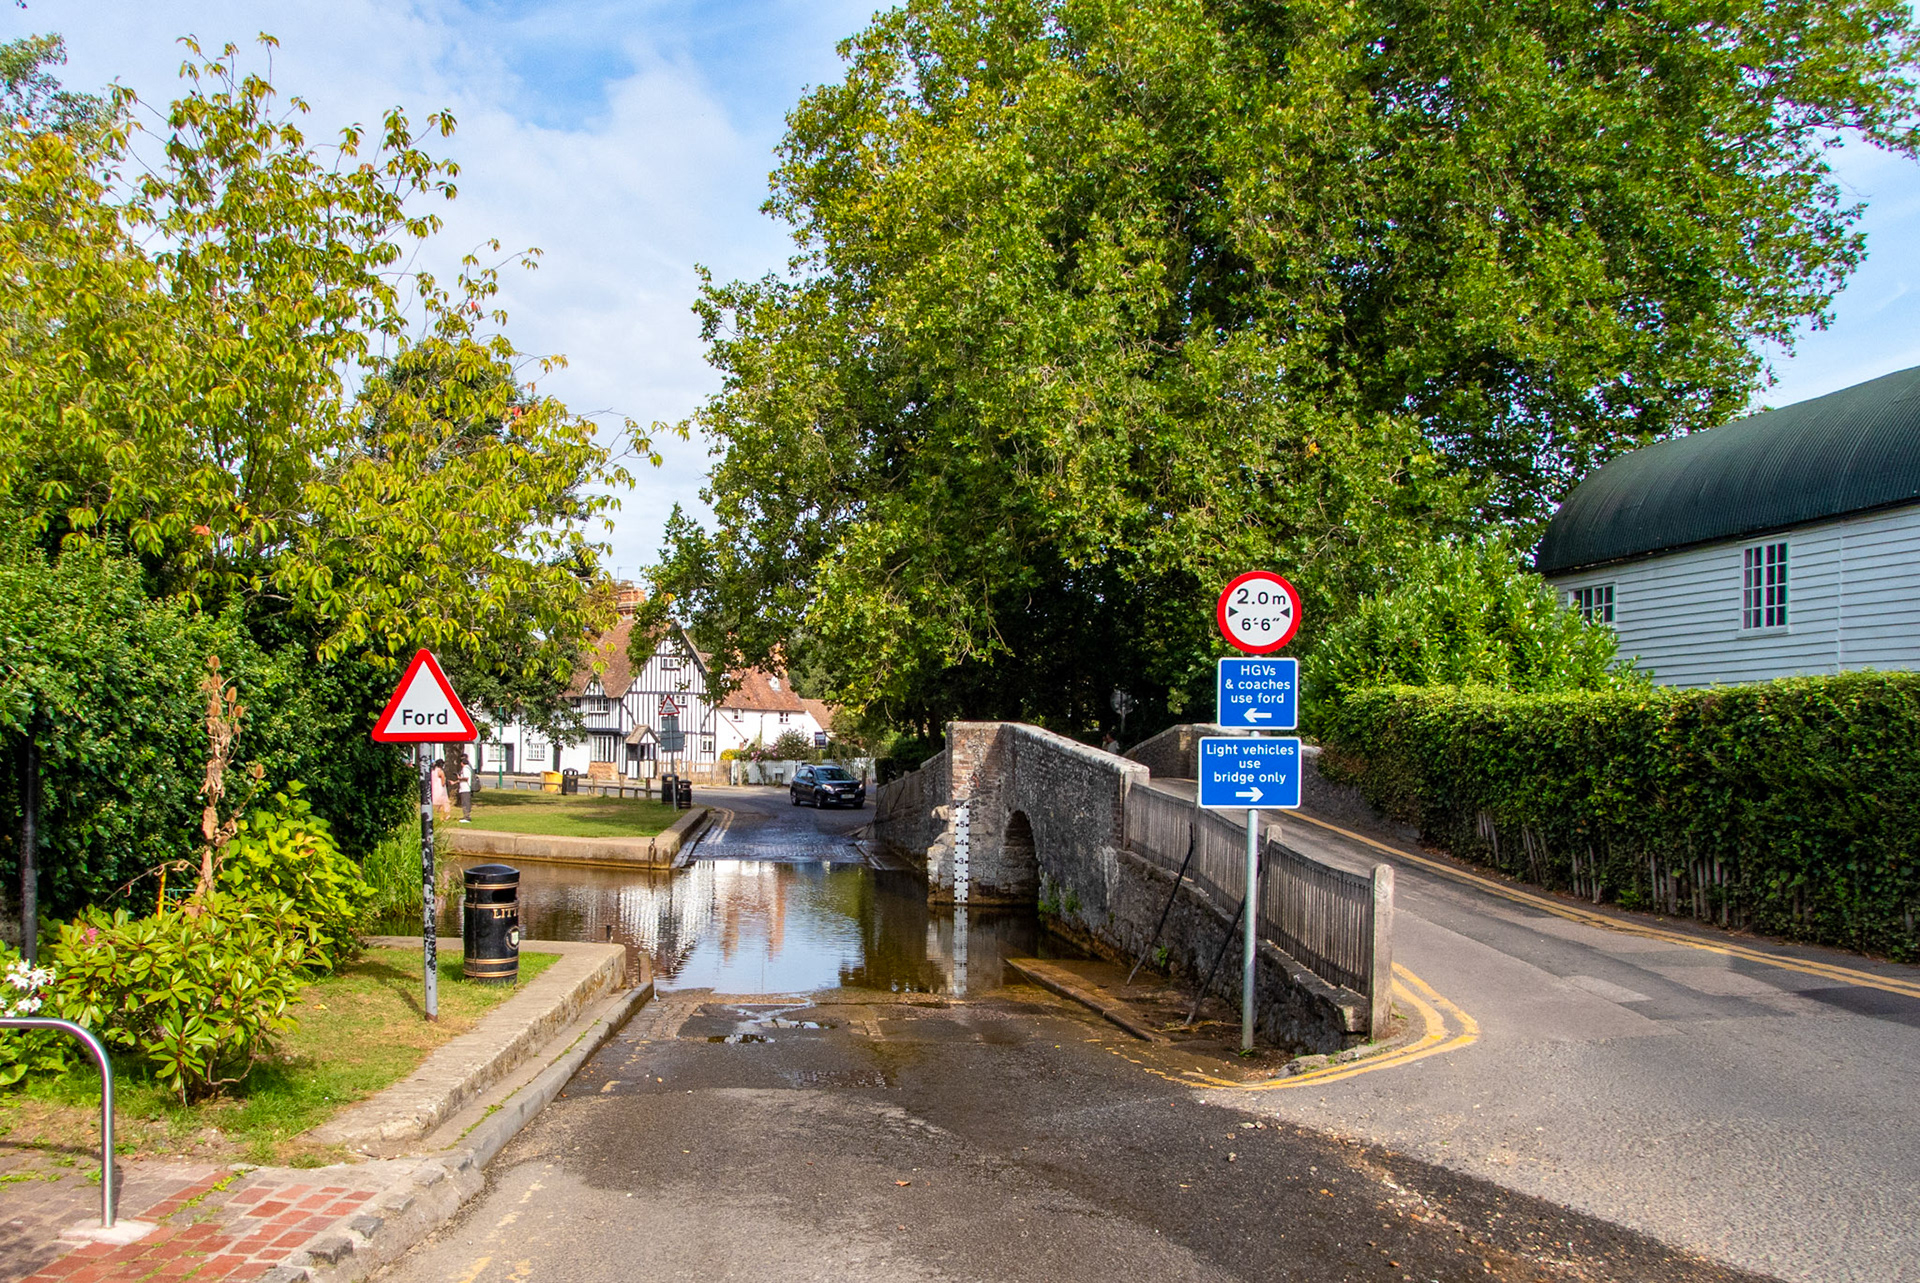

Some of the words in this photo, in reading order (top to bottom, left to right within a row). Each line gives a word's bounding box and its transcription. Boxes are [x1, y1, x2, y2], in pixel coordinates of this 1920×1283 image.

[1240, 664, 1276, 676] HGVs
[1225, 678, 1234, 690] &
[1238, 678, 1291, 690] coaches
[1230, 694, 1253, 704] use
[1257, 692, 1285, 704] ford
[402, 708, 448, 726] Ford
[1206, 744, 1238, 757] Light
[1242, 744, 1294, 755] vehicles
[1238, 760, 1261, 769] use
[1213, 771, 1255, 785] bridge
[1258, 771, 1287, 785] only
[959, 820, 965, 828] 5
[959, 839, 965, 847] 4
[958, 857, 965, 865] 3
[958, 875, 964, 884] 2
